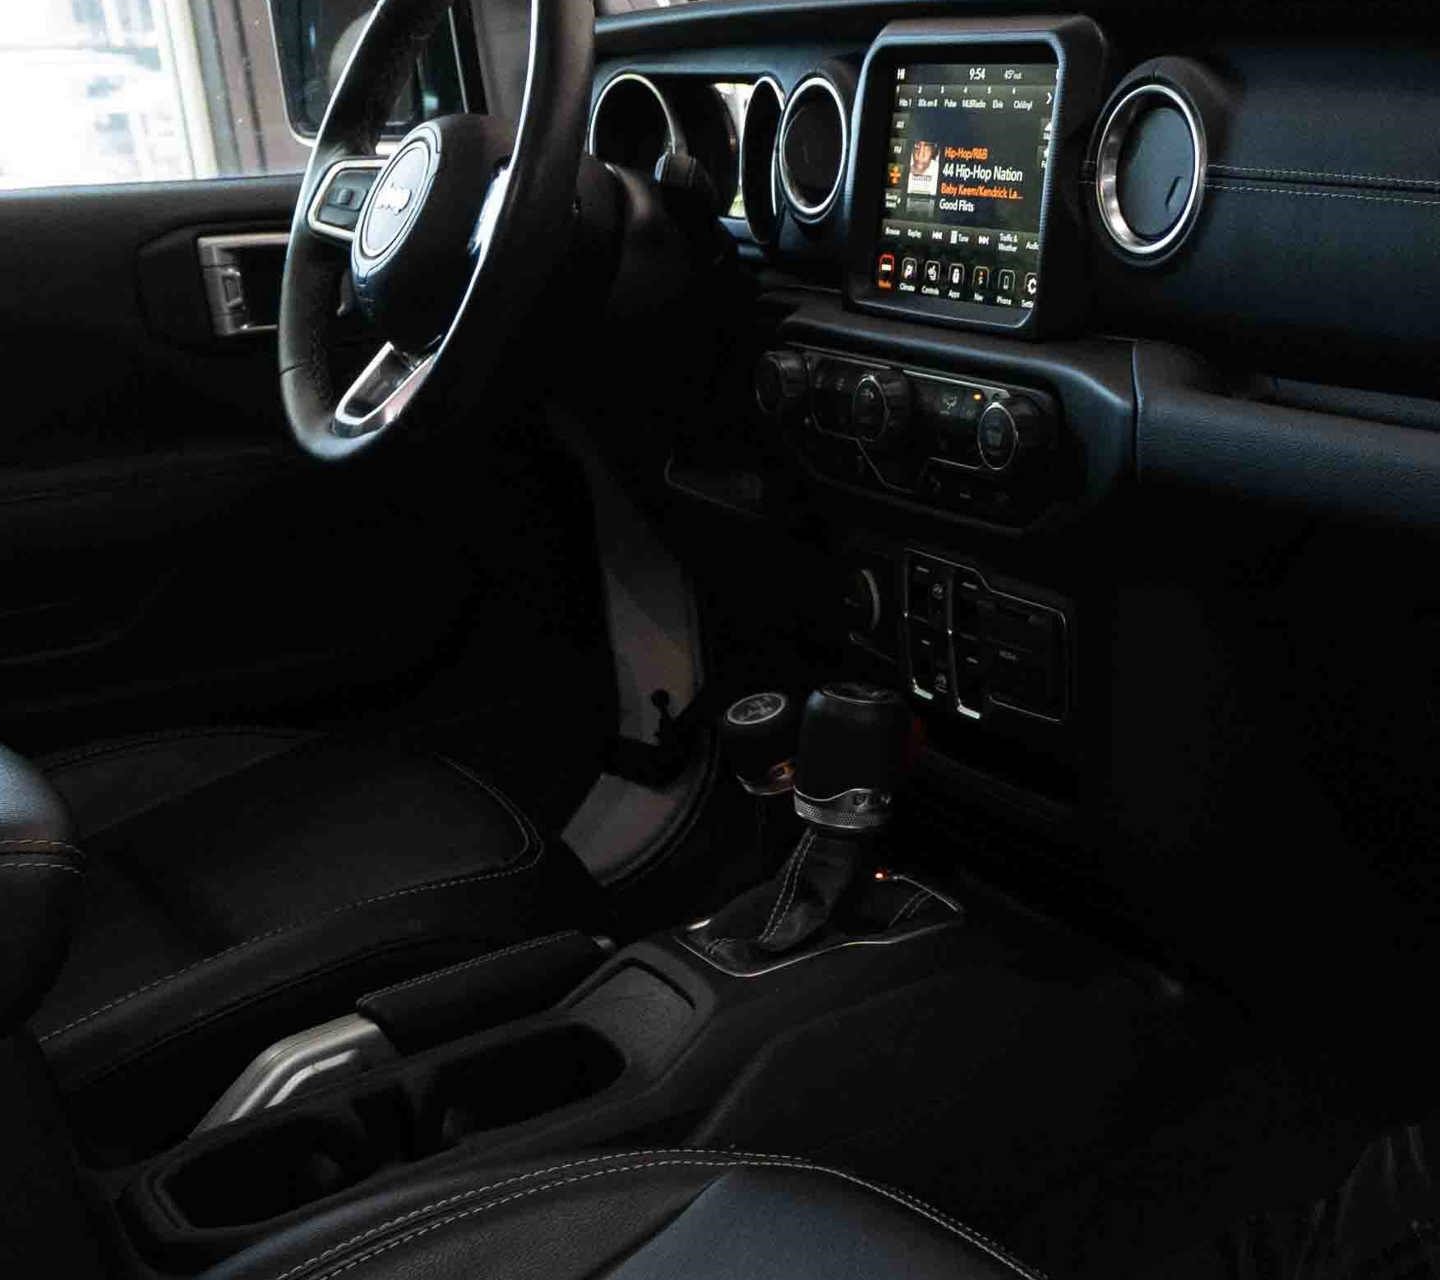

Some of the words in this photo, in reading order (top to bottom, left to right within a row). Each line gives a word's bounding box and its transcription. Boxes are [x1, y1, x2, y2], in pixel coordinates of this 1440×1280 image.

[969, 67, 986, 81] 9:54
[944, 147, 988, 161] Hip-Hop/R&B
[942, 164, 954, 177] 44
[956, 164, 991, 182] Hip-Hop
[993, 166, 1023, 182] Nation
[941, 183, 956, 197] Baby
[939, 199, 957, 211] Good
